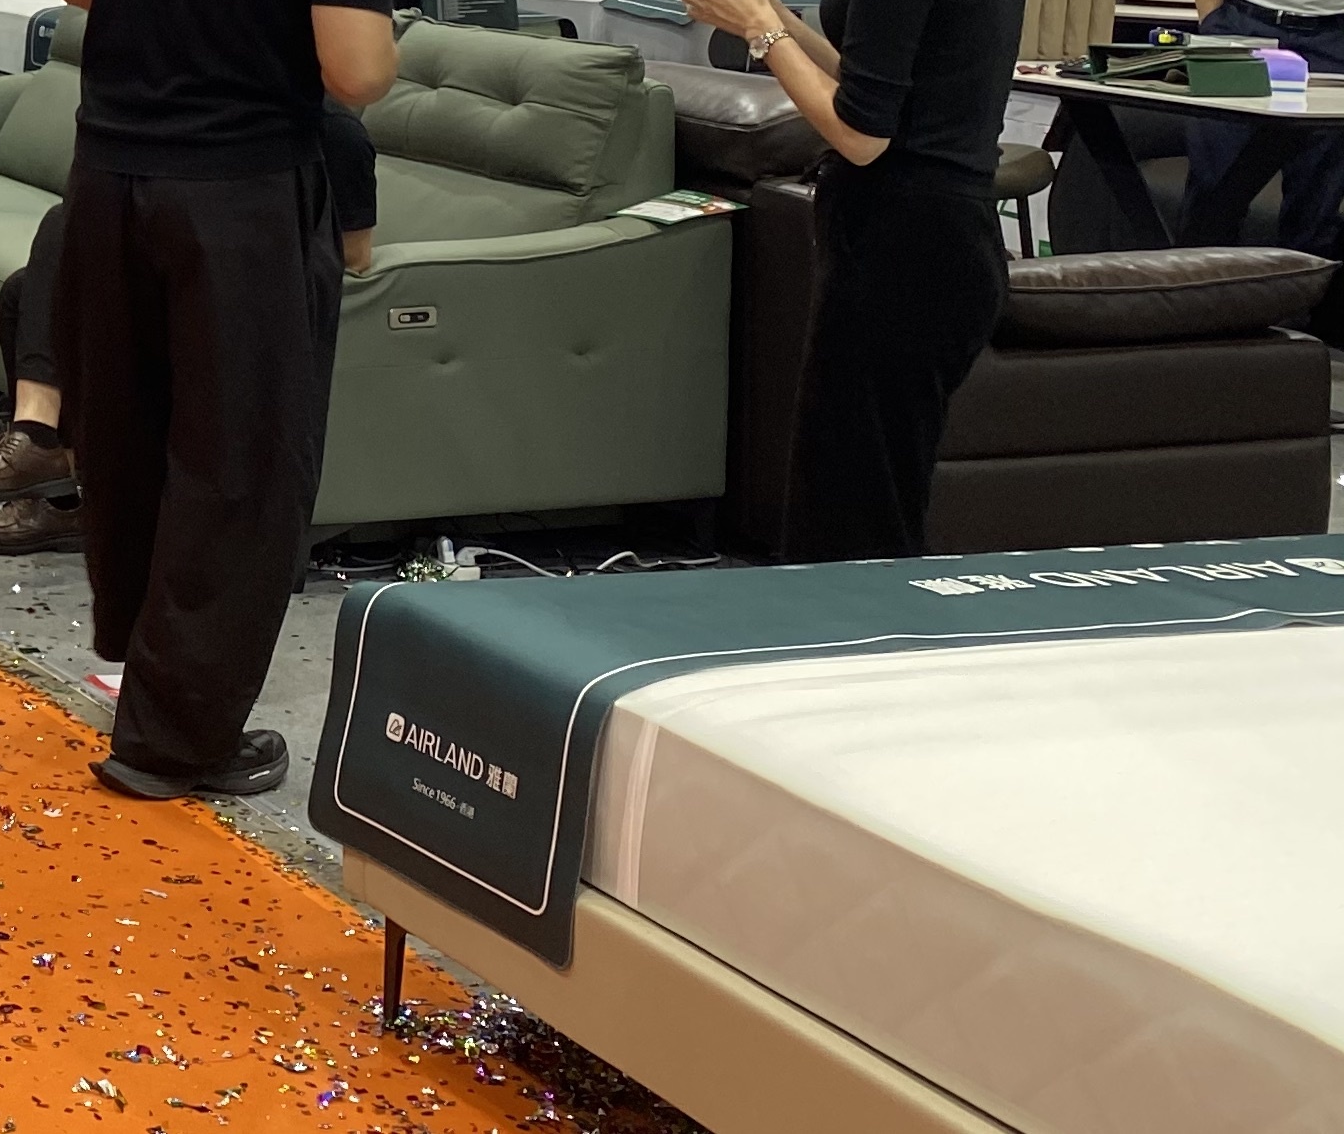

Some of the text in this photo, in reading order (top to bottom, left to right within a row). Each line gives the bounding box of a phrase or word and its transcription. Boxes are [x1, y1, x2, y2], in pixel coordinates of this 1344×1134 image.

[404, 723, 484, 780] AIRLAND
[412, 777, 435, 799] Since
[435, 789, 456, 810] 1966
